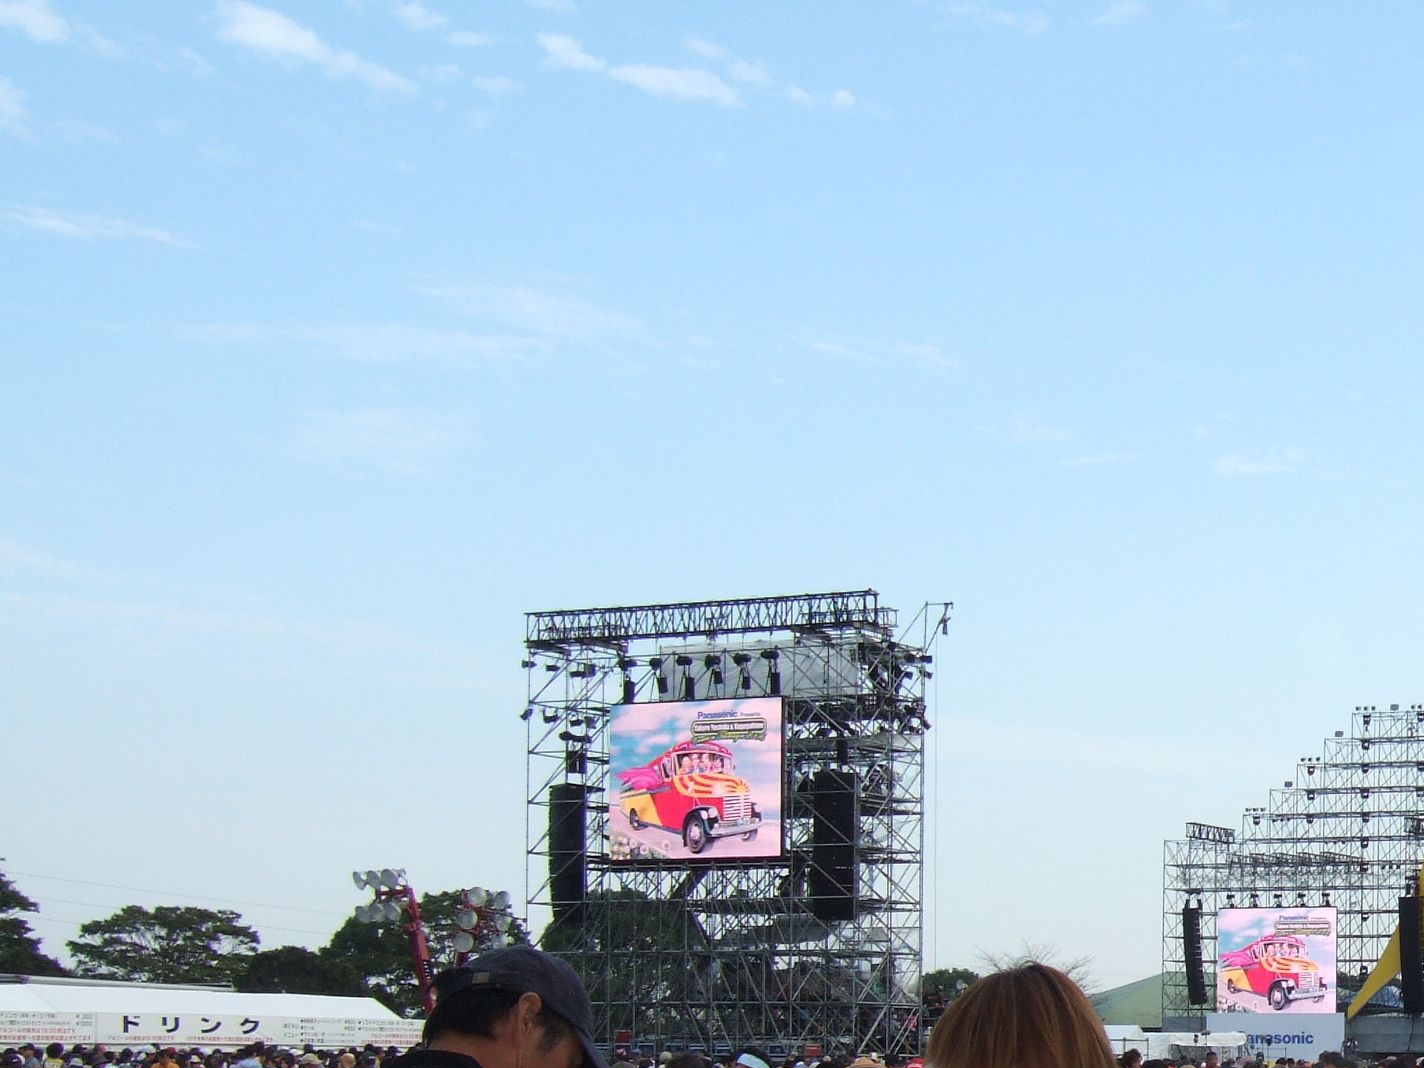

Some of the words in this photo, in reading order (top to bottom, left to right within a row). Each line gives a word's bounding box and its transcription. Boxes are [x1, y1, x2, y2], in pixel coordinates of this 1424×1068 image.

[697, 711, 738, 719] Panasonic
[122, 1015, 260, 1035] ドリンク
[1247, 1031, 1314, 1045] anasonic
